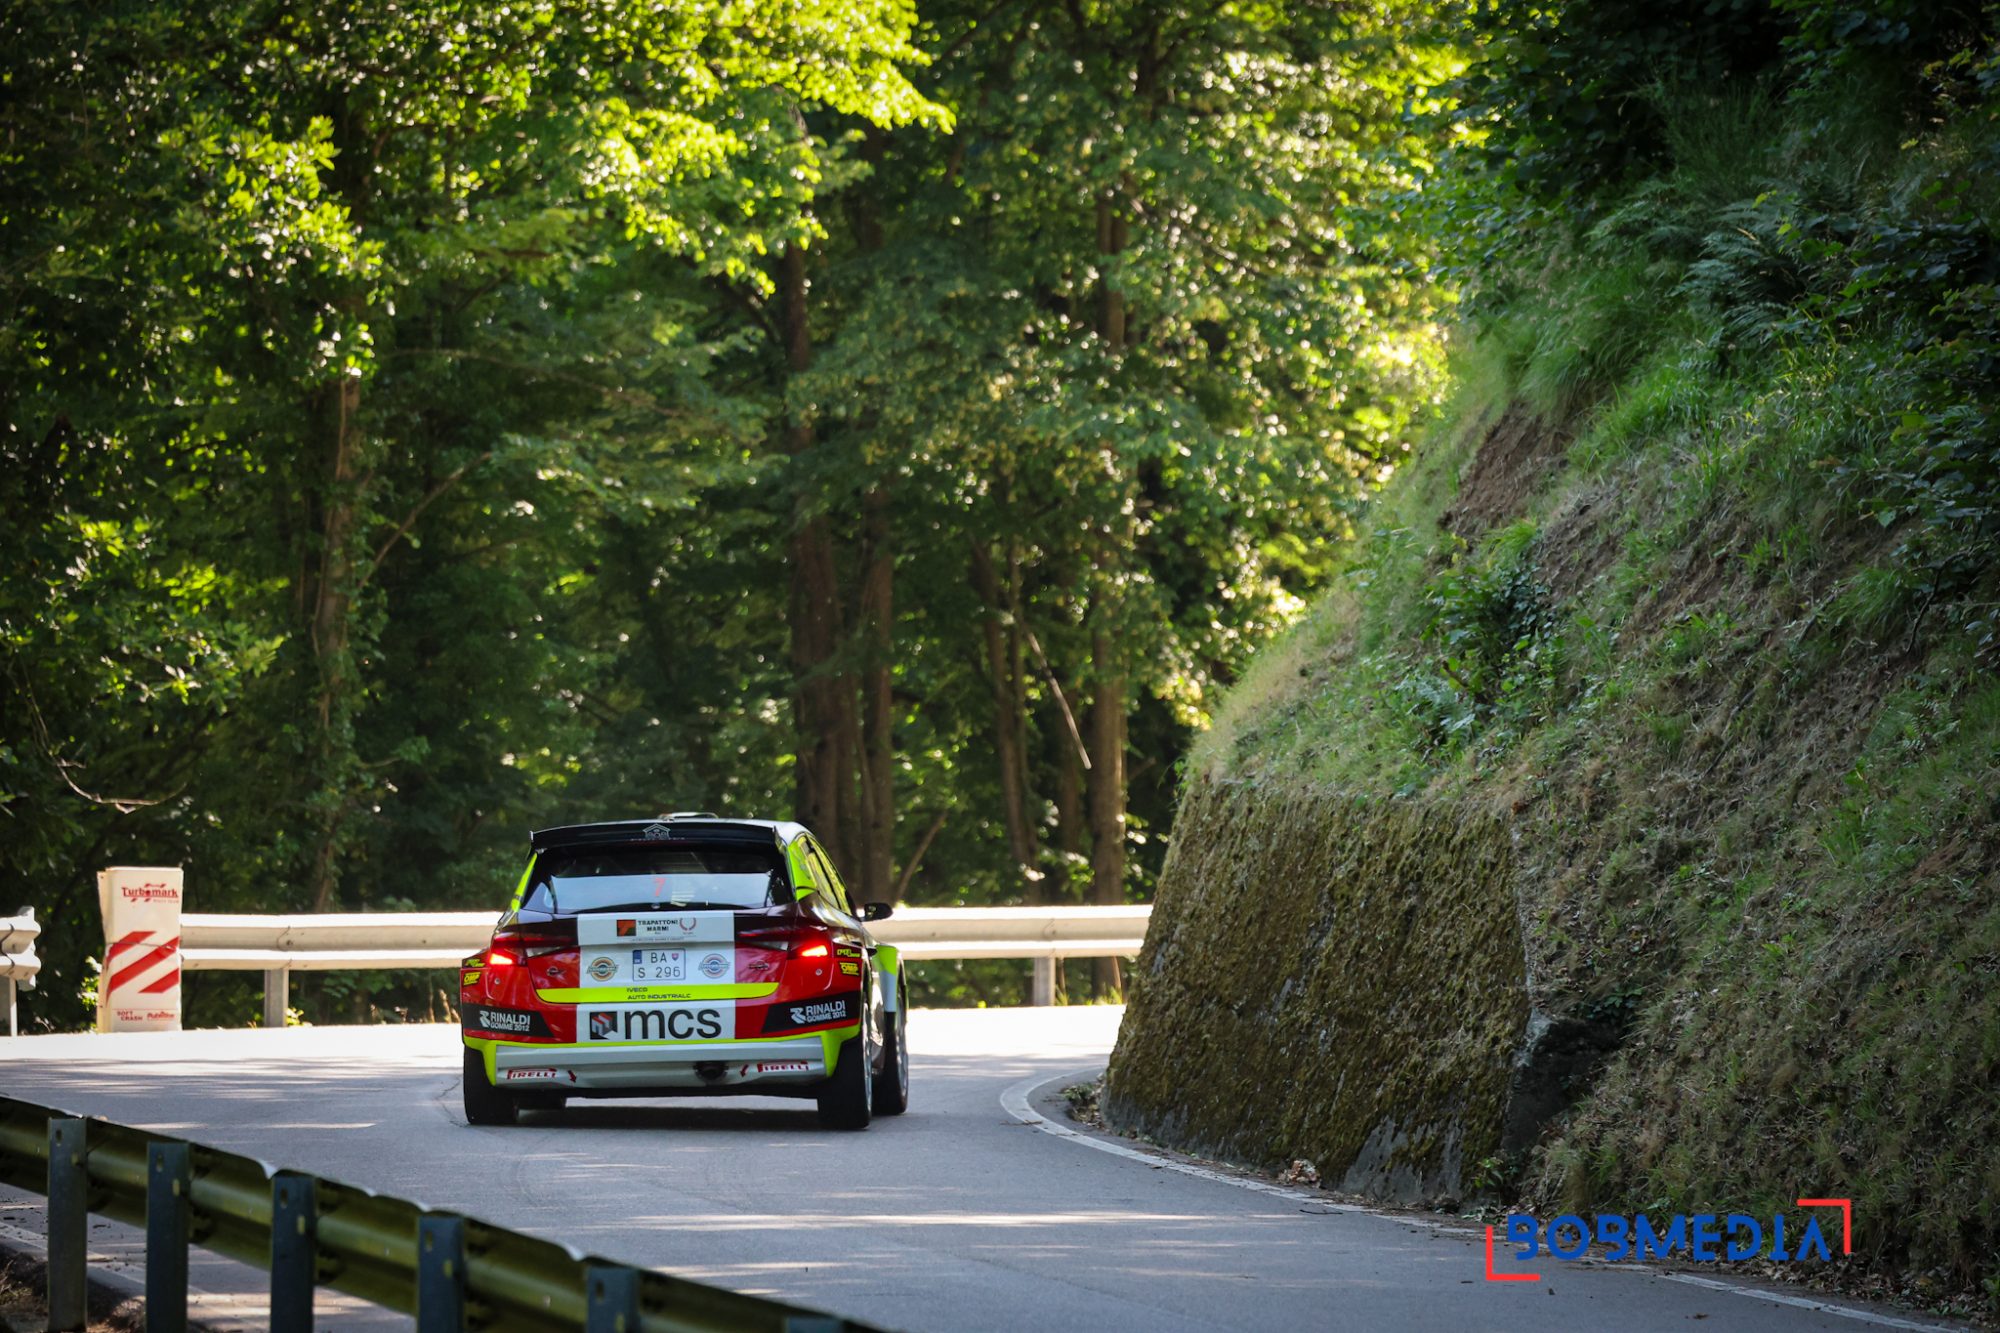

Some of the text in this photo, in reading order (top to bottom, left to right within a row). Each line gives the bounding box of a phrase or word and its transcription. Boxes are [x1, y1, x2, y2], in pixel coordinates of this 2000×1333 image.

[121, 886, 179, 898] Turbomark
[654, 877, 666, 897] 7
[650, 952, 667, 964] BA
[638, 966, 681, 979] S 296
[806, 1000, 846, 1016] RINALDI
[490, 1011, 531, 1025] RINALDI
[806, 1011, 847, 1023] GOMME 2012
[490, 1021, 530, 1032] GOMME 2012
[624, 1009, 722, 1040] mcs
[757, 1061, 809, 1072] PIRELLI
[506, 1068, 557, 1080] PIRELLI
